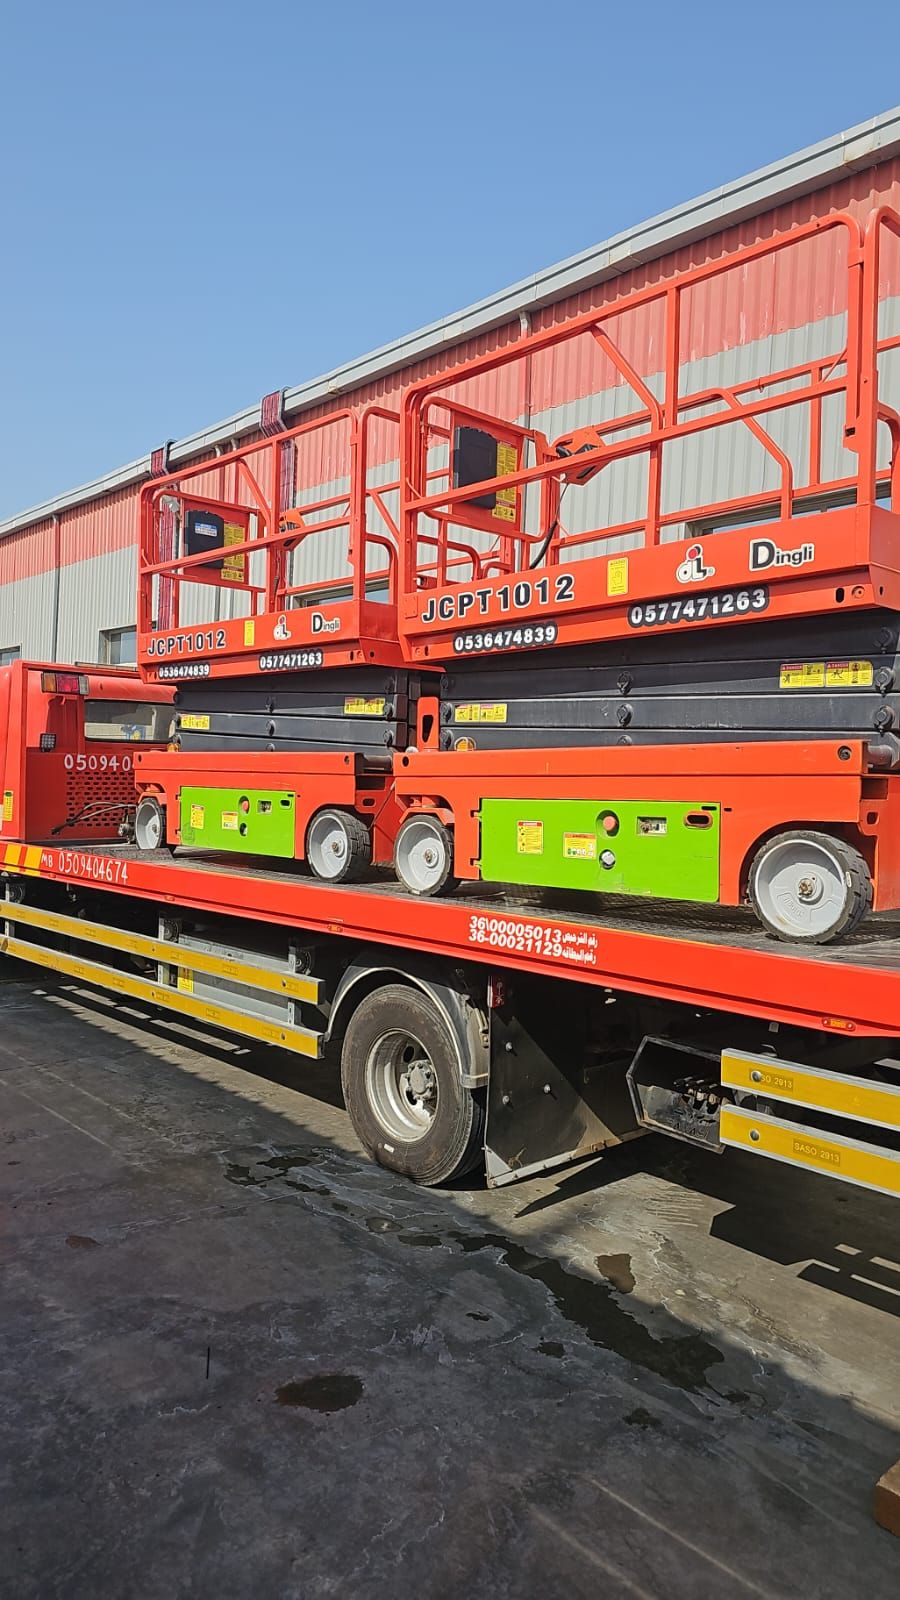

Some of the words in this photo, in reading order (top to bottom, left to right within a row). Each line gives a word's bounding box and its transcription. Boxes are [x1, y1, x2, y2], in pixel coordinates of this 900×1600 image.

[751, 540, 814, 570] Dingli
[421, 574, 575, 622] JCPT1012
[630, 588, 767, 625] 0577471263
[312, 613, 340, 633] Dingli
[147, 630, 227, 657] JCPT1012
[454, 625, 556, 652] 0536474839
[158, 664, 210, 678] 0536474839
[260, 652, 323, 668] 0577471263
[64, 754, 135, 771] 050940
[58, 852, 128, 884] 0509404674
[468, 928, 563, 957] 36-00021129
[794, 1142, 817, 1156] SASO
